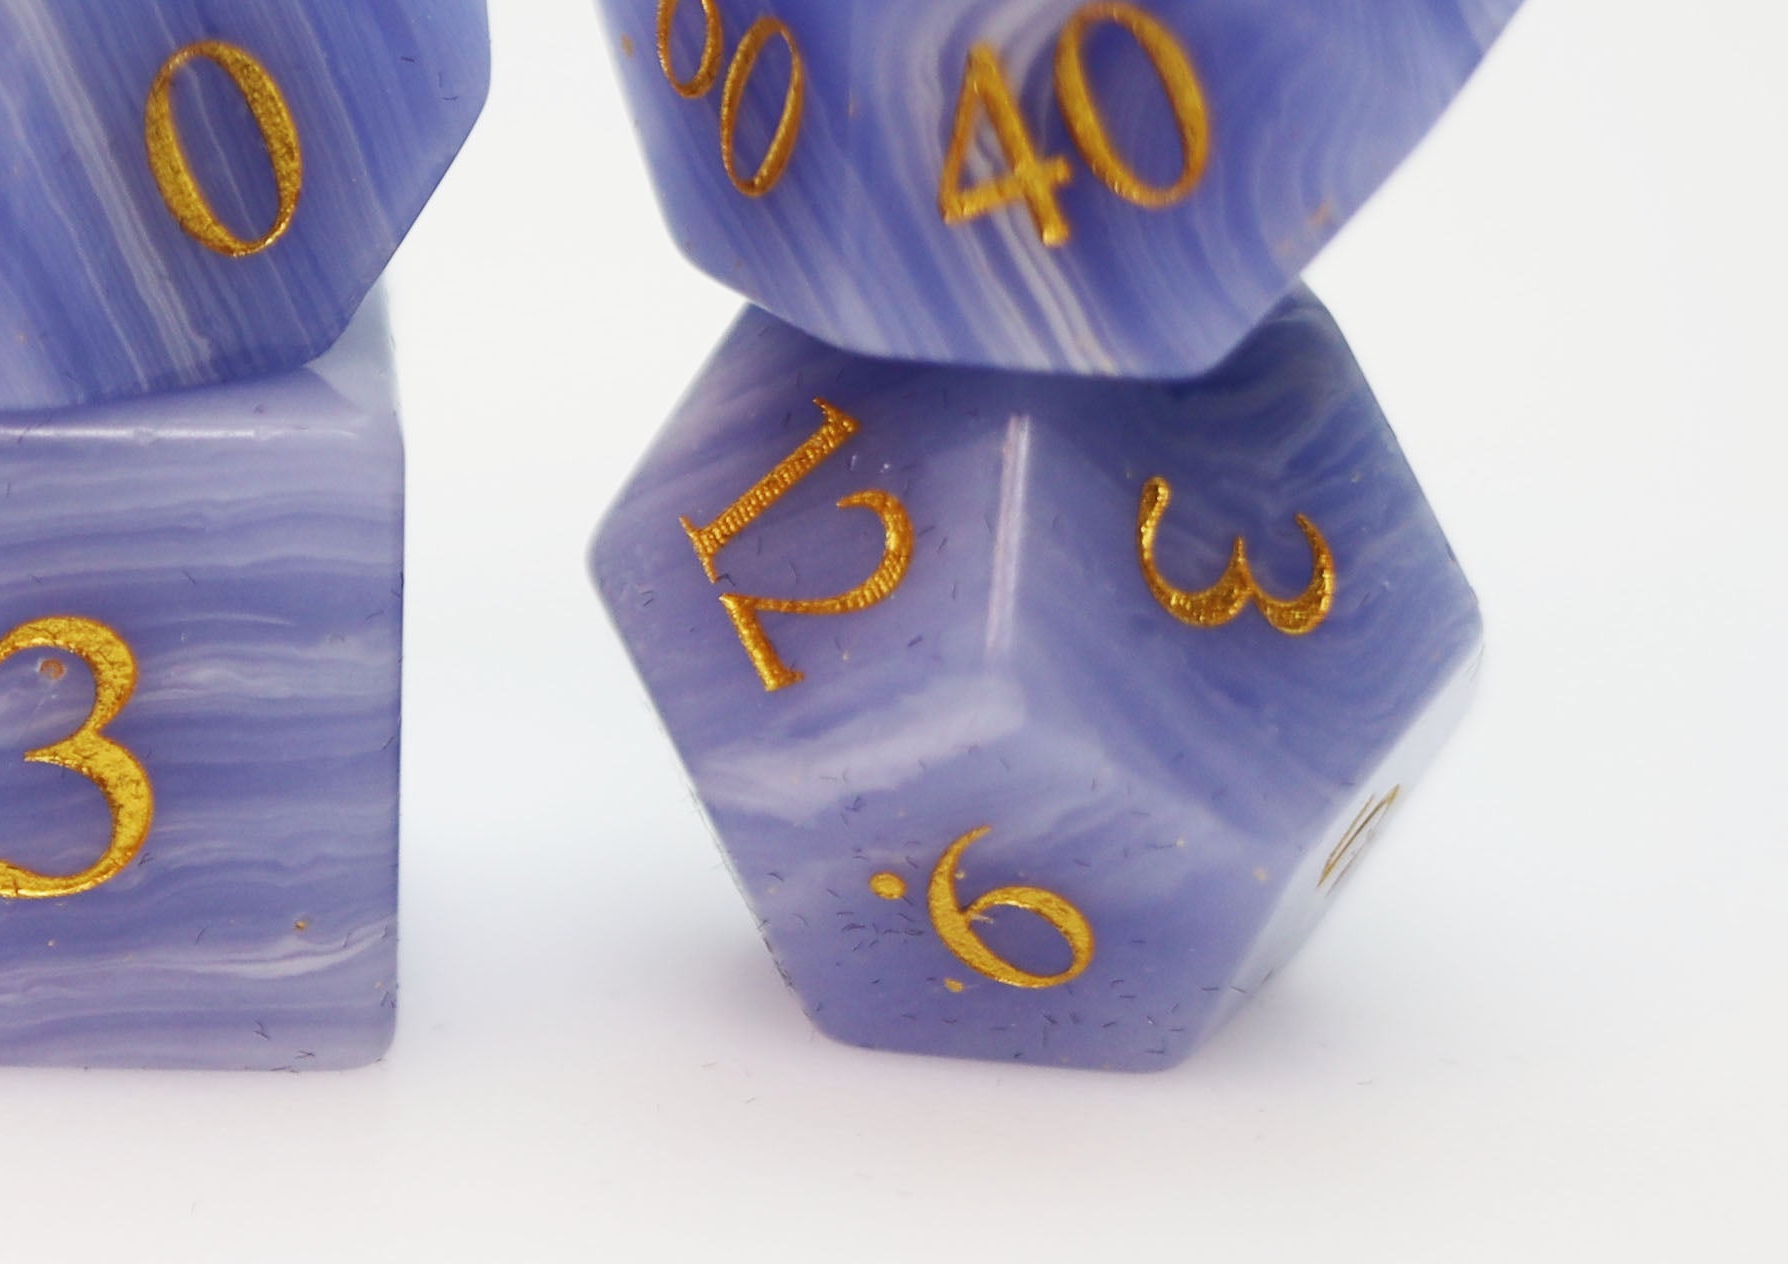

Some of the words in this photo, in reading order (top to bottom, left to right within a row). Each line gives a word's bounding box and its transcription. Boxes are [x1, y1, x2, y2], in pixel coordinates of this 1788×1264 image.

[142, 38, 304, 259] 0
[677, 395, 917, 693] 12
[1134, 474, 1337, 637] 3
